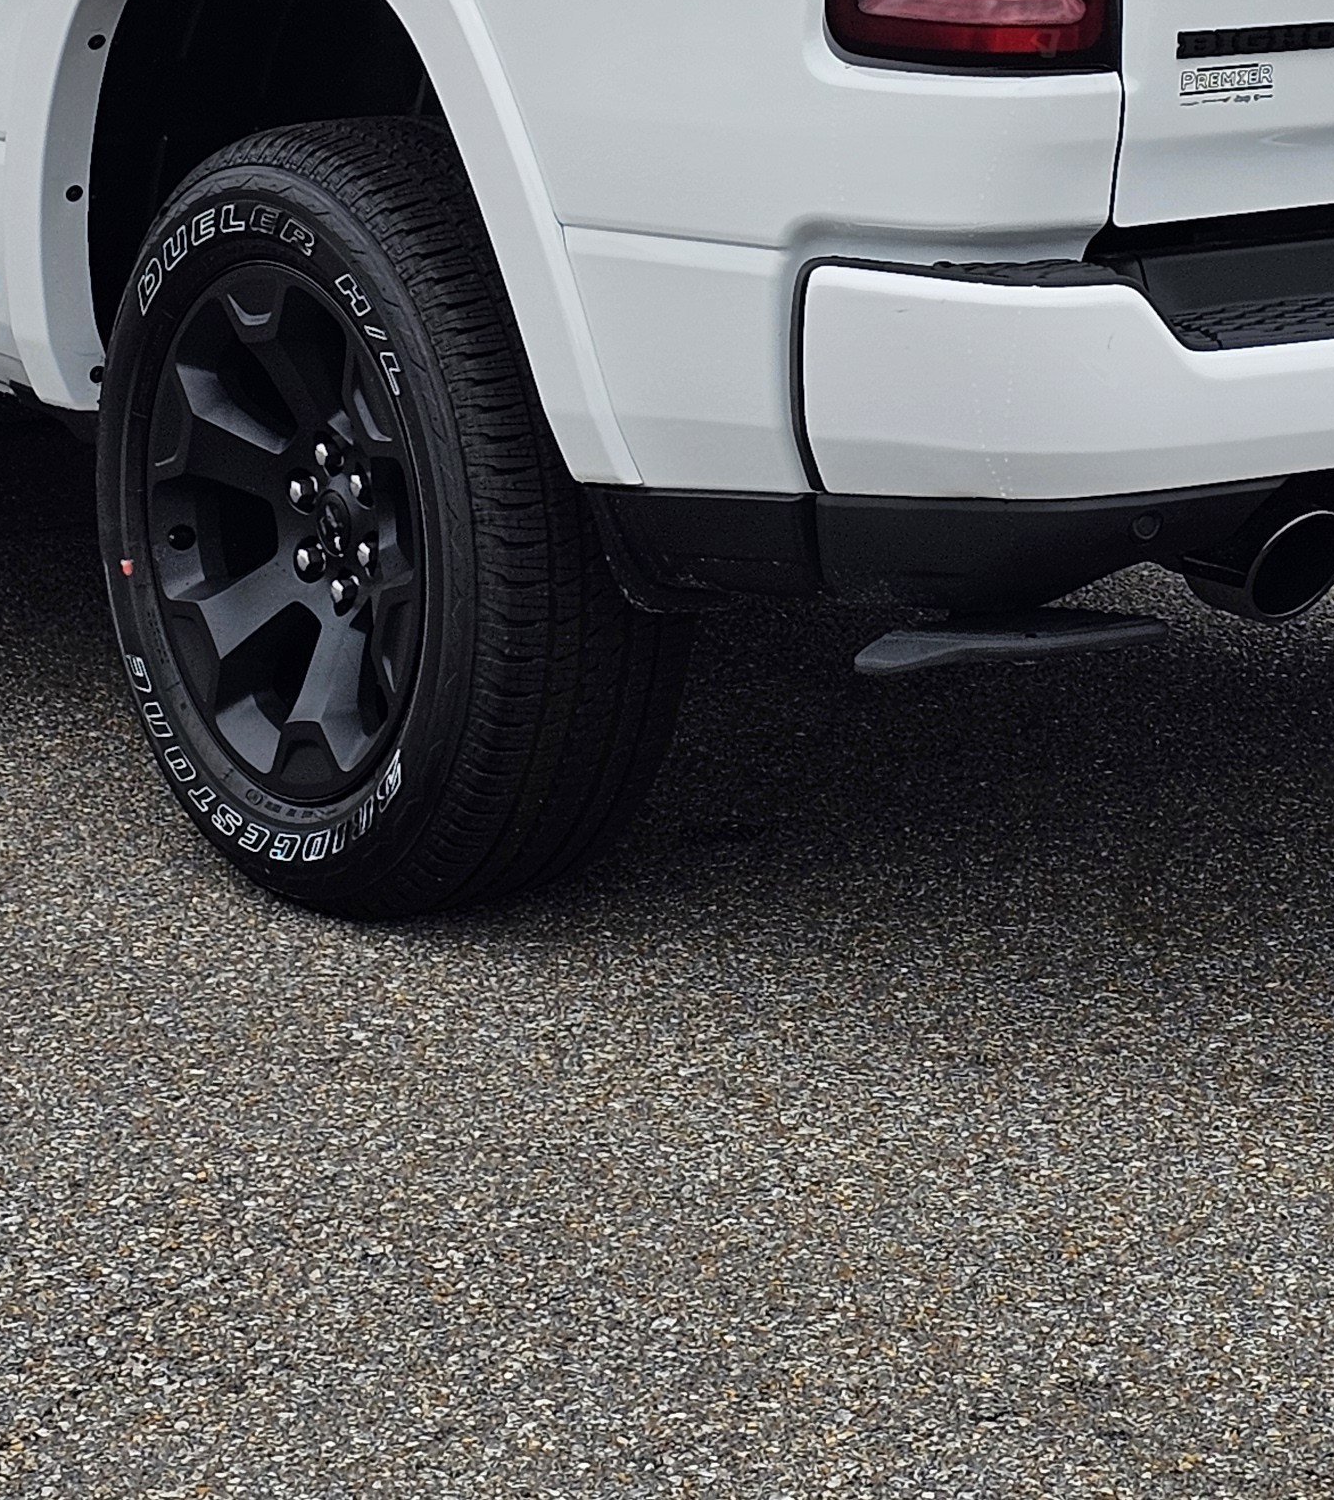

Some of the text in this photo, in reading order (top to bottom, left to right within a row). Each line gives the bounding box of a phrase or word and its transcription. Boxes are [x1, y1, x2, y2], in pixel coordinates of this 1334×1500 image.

[1180, 64, 1273, 90] PREMIER
[137, 204, 315, 316] DUELER
[125, 654, 402, 861] BRIDGESTONE
